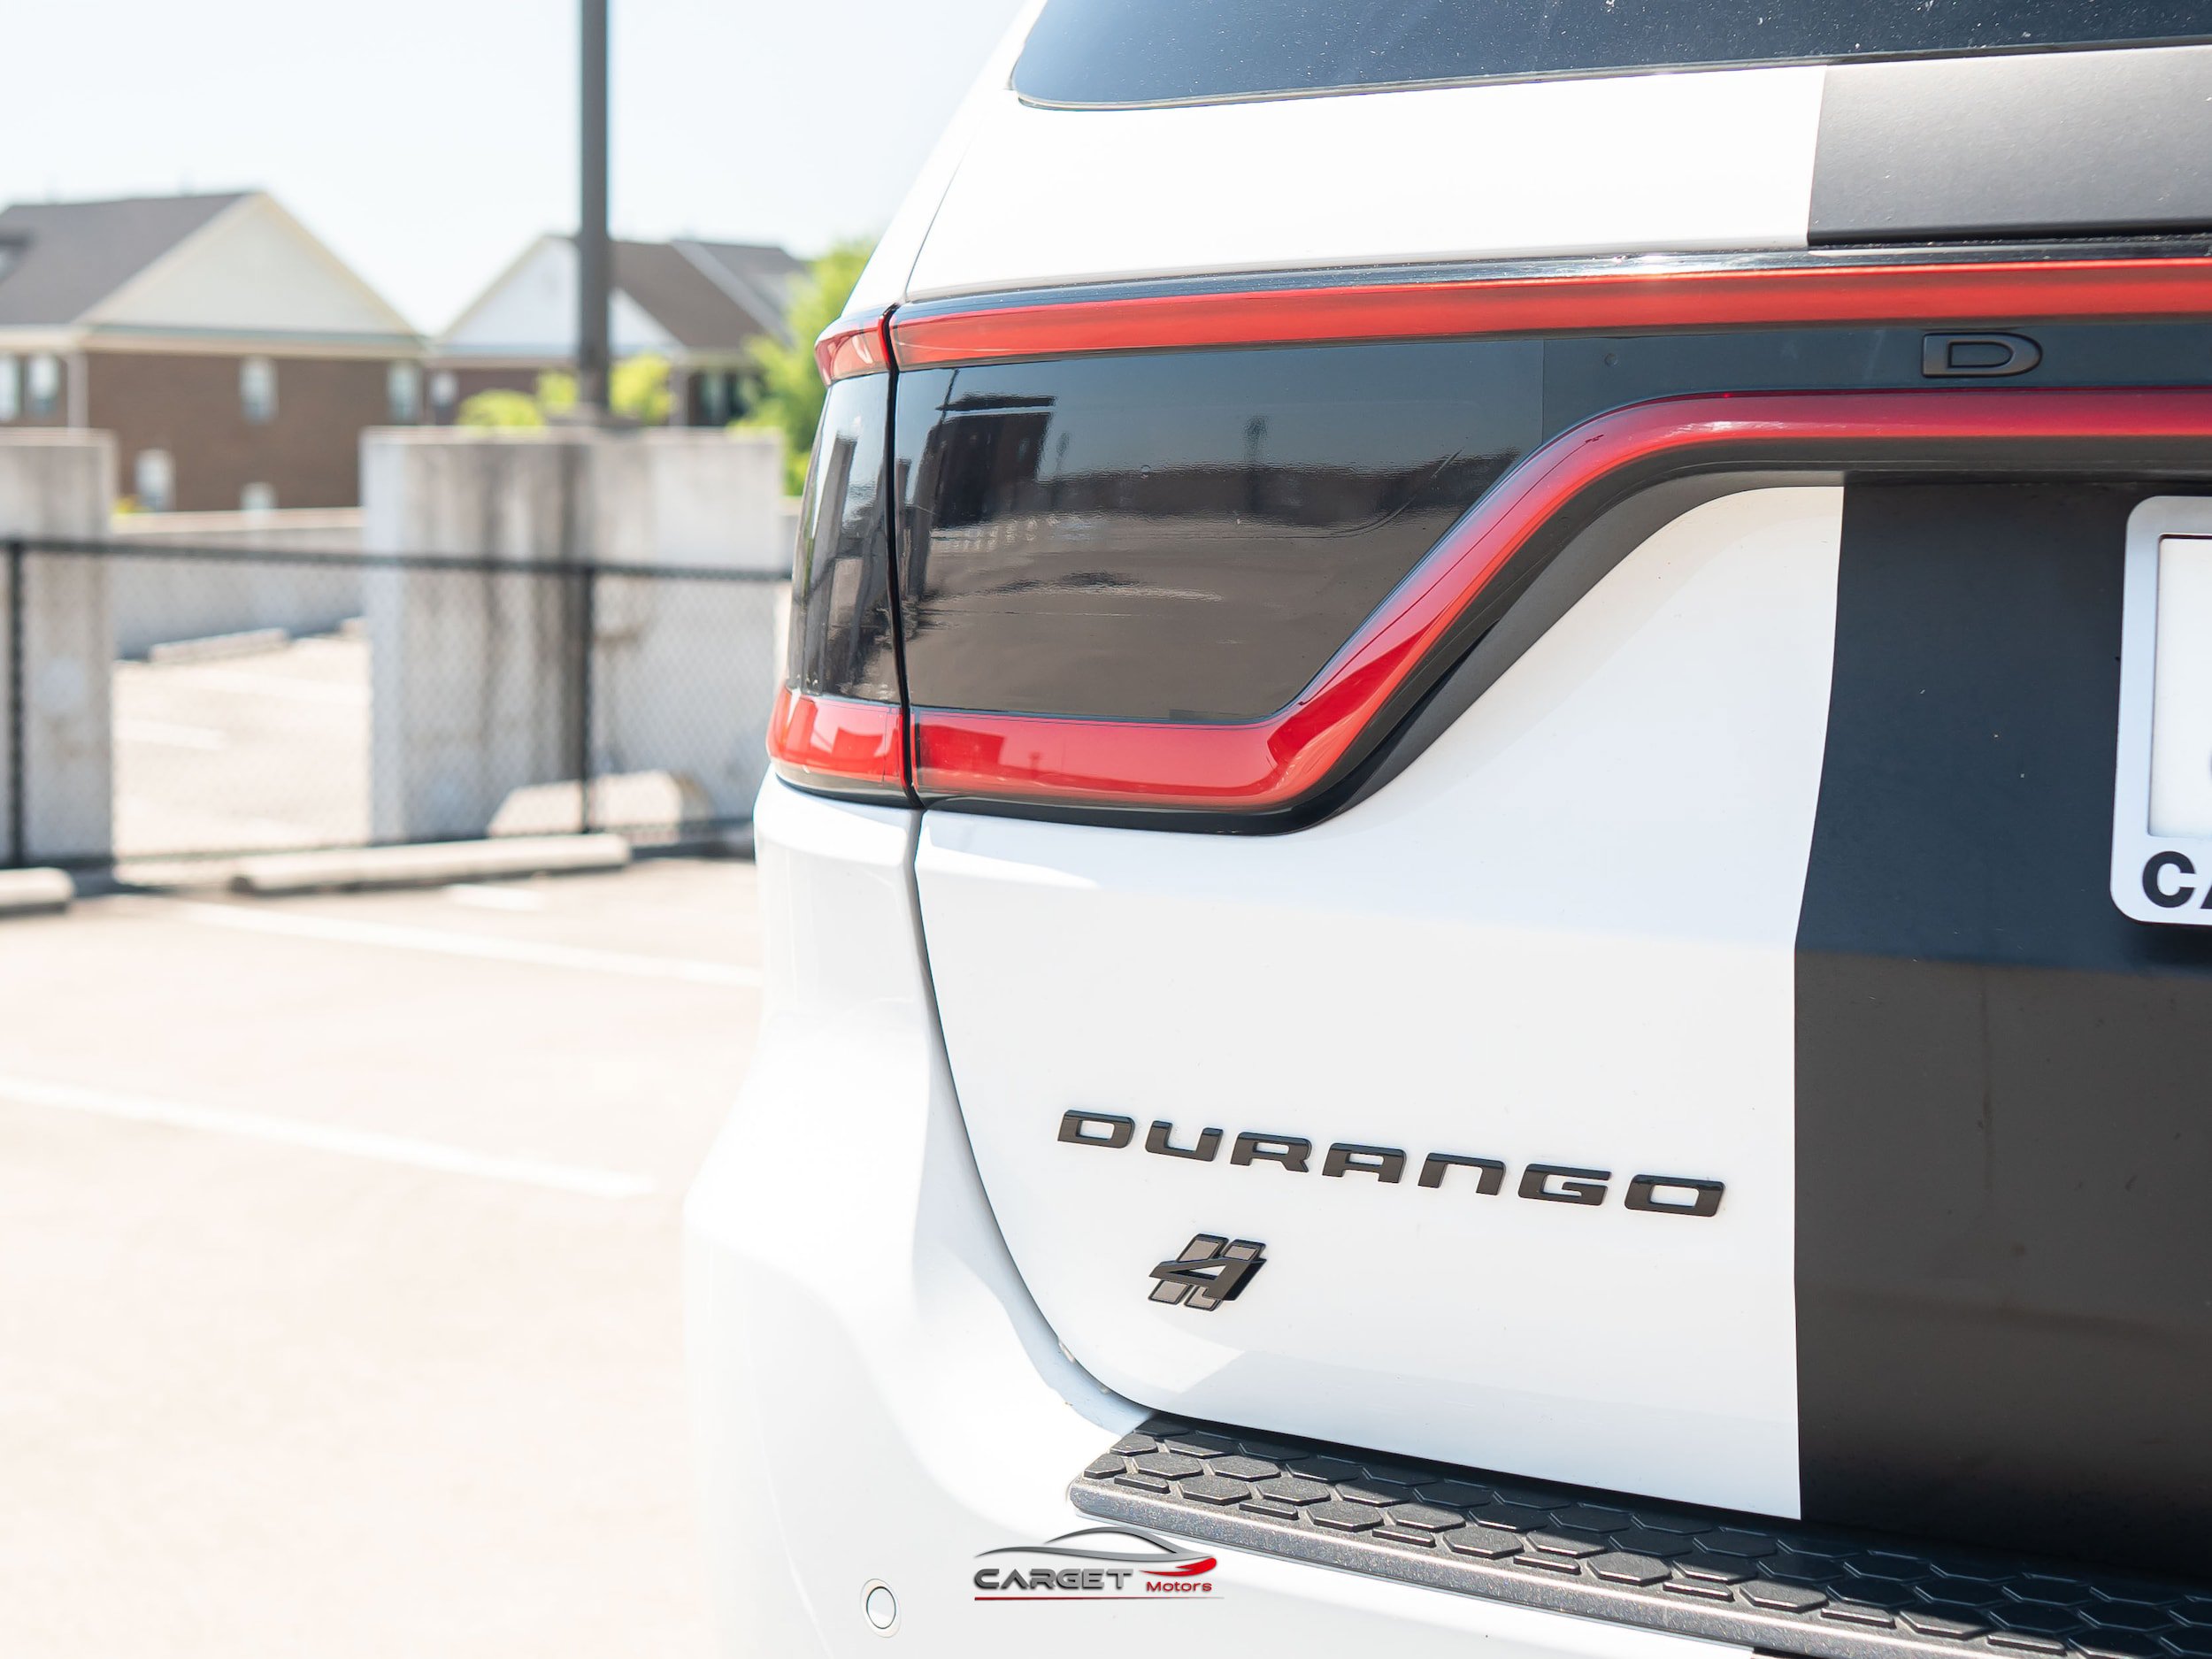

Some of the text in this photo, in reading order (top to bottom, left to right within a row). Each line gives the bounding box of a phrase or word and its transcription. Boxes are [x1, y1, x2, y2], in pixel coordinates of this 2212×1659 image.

[1922, 332, 2042, 378] D
[2142, 850, 2212, 910] C
[1057, 1110, 1725, 1217] DURANGO
